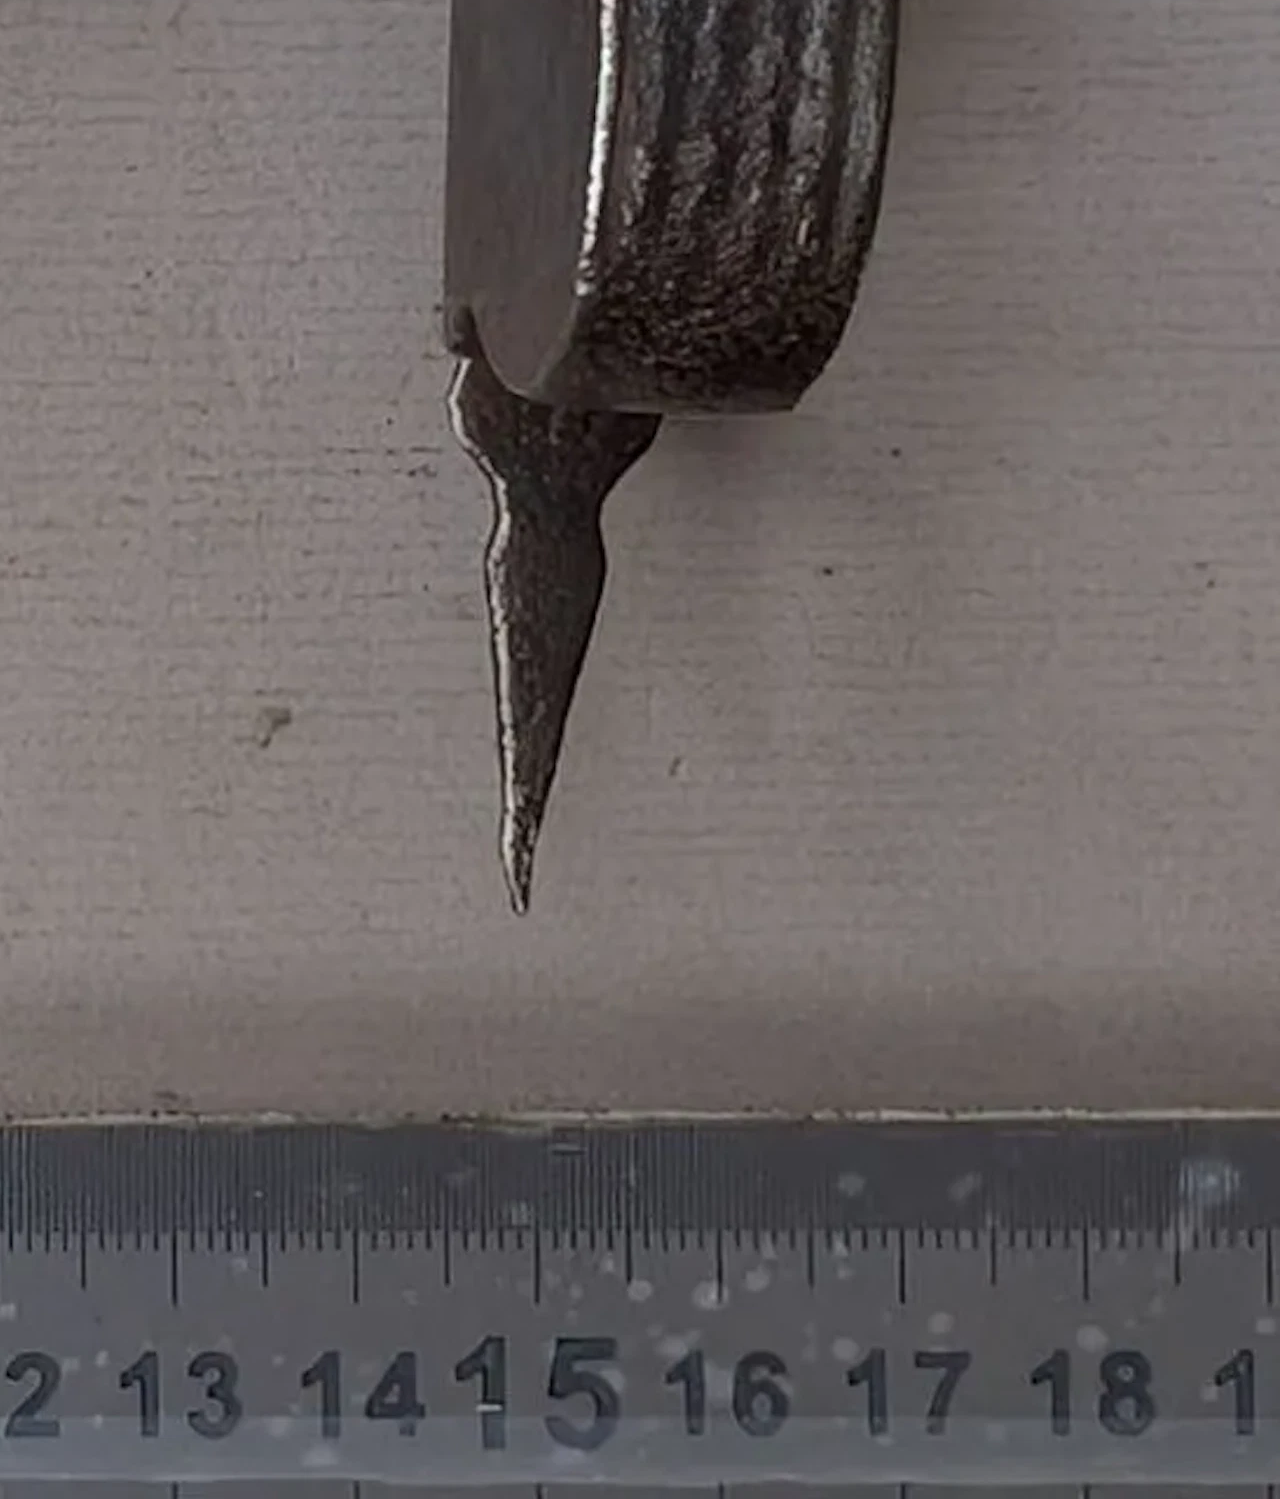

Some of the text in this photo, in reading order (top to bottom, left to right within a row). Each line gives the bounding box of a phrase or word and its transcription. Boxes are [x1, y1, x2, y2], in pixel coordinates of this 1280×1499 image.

[119, 1351, 242, 1437] 13
[301, 1352, 426, 1435] 14
[454, 1336, 621, 1450] 15
[666, 1351, 790, 1436] 16
[847, 1350, 971, 1435] 17
[1030, 1349, 1156, 1435] 18
